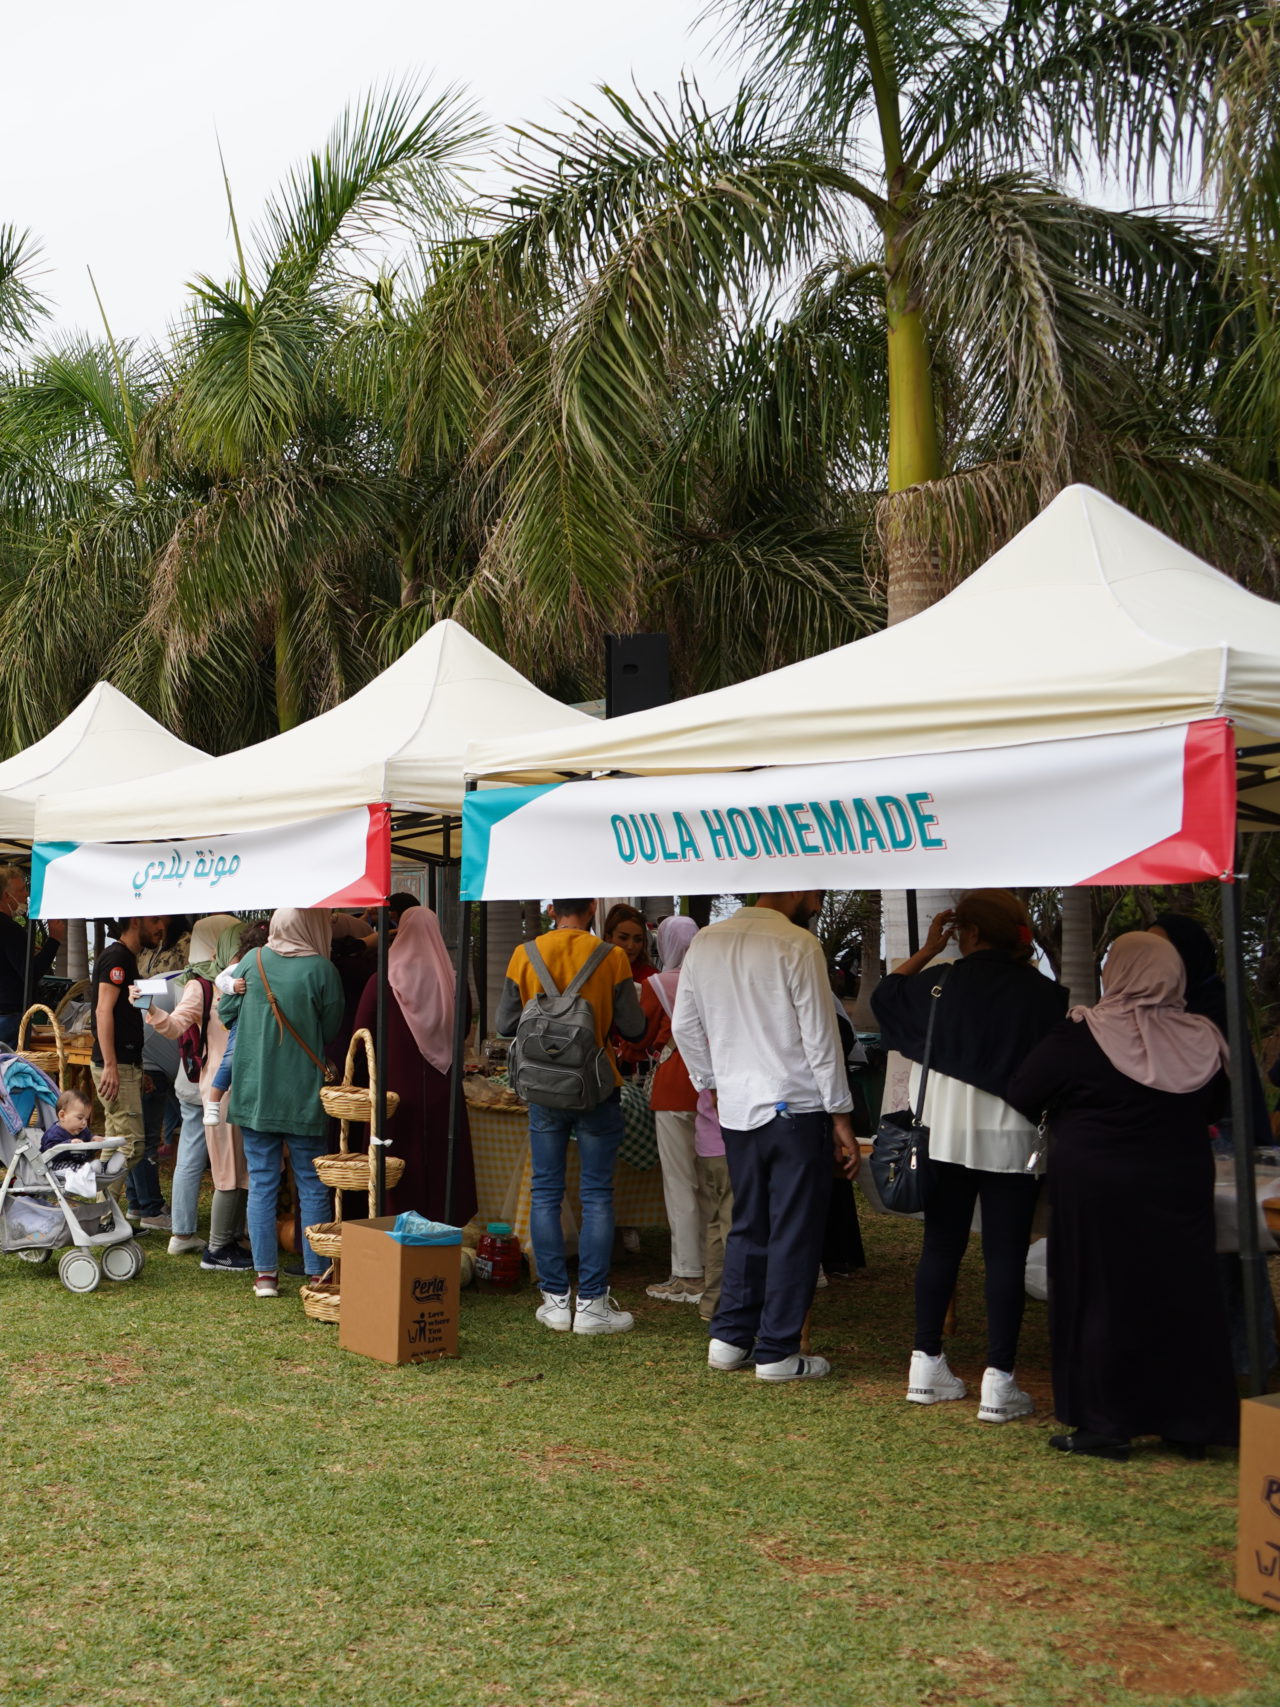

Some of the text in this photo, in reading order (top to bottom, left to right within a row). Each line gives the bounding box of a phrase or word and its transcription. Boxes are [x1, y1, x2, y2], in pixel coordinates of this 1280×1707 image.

[610, 792, 947, 865] OULA HOMEMADE
[132, 848, 241, 899] مونة بلادي
[412, 1277, 447, 1298] Perla
